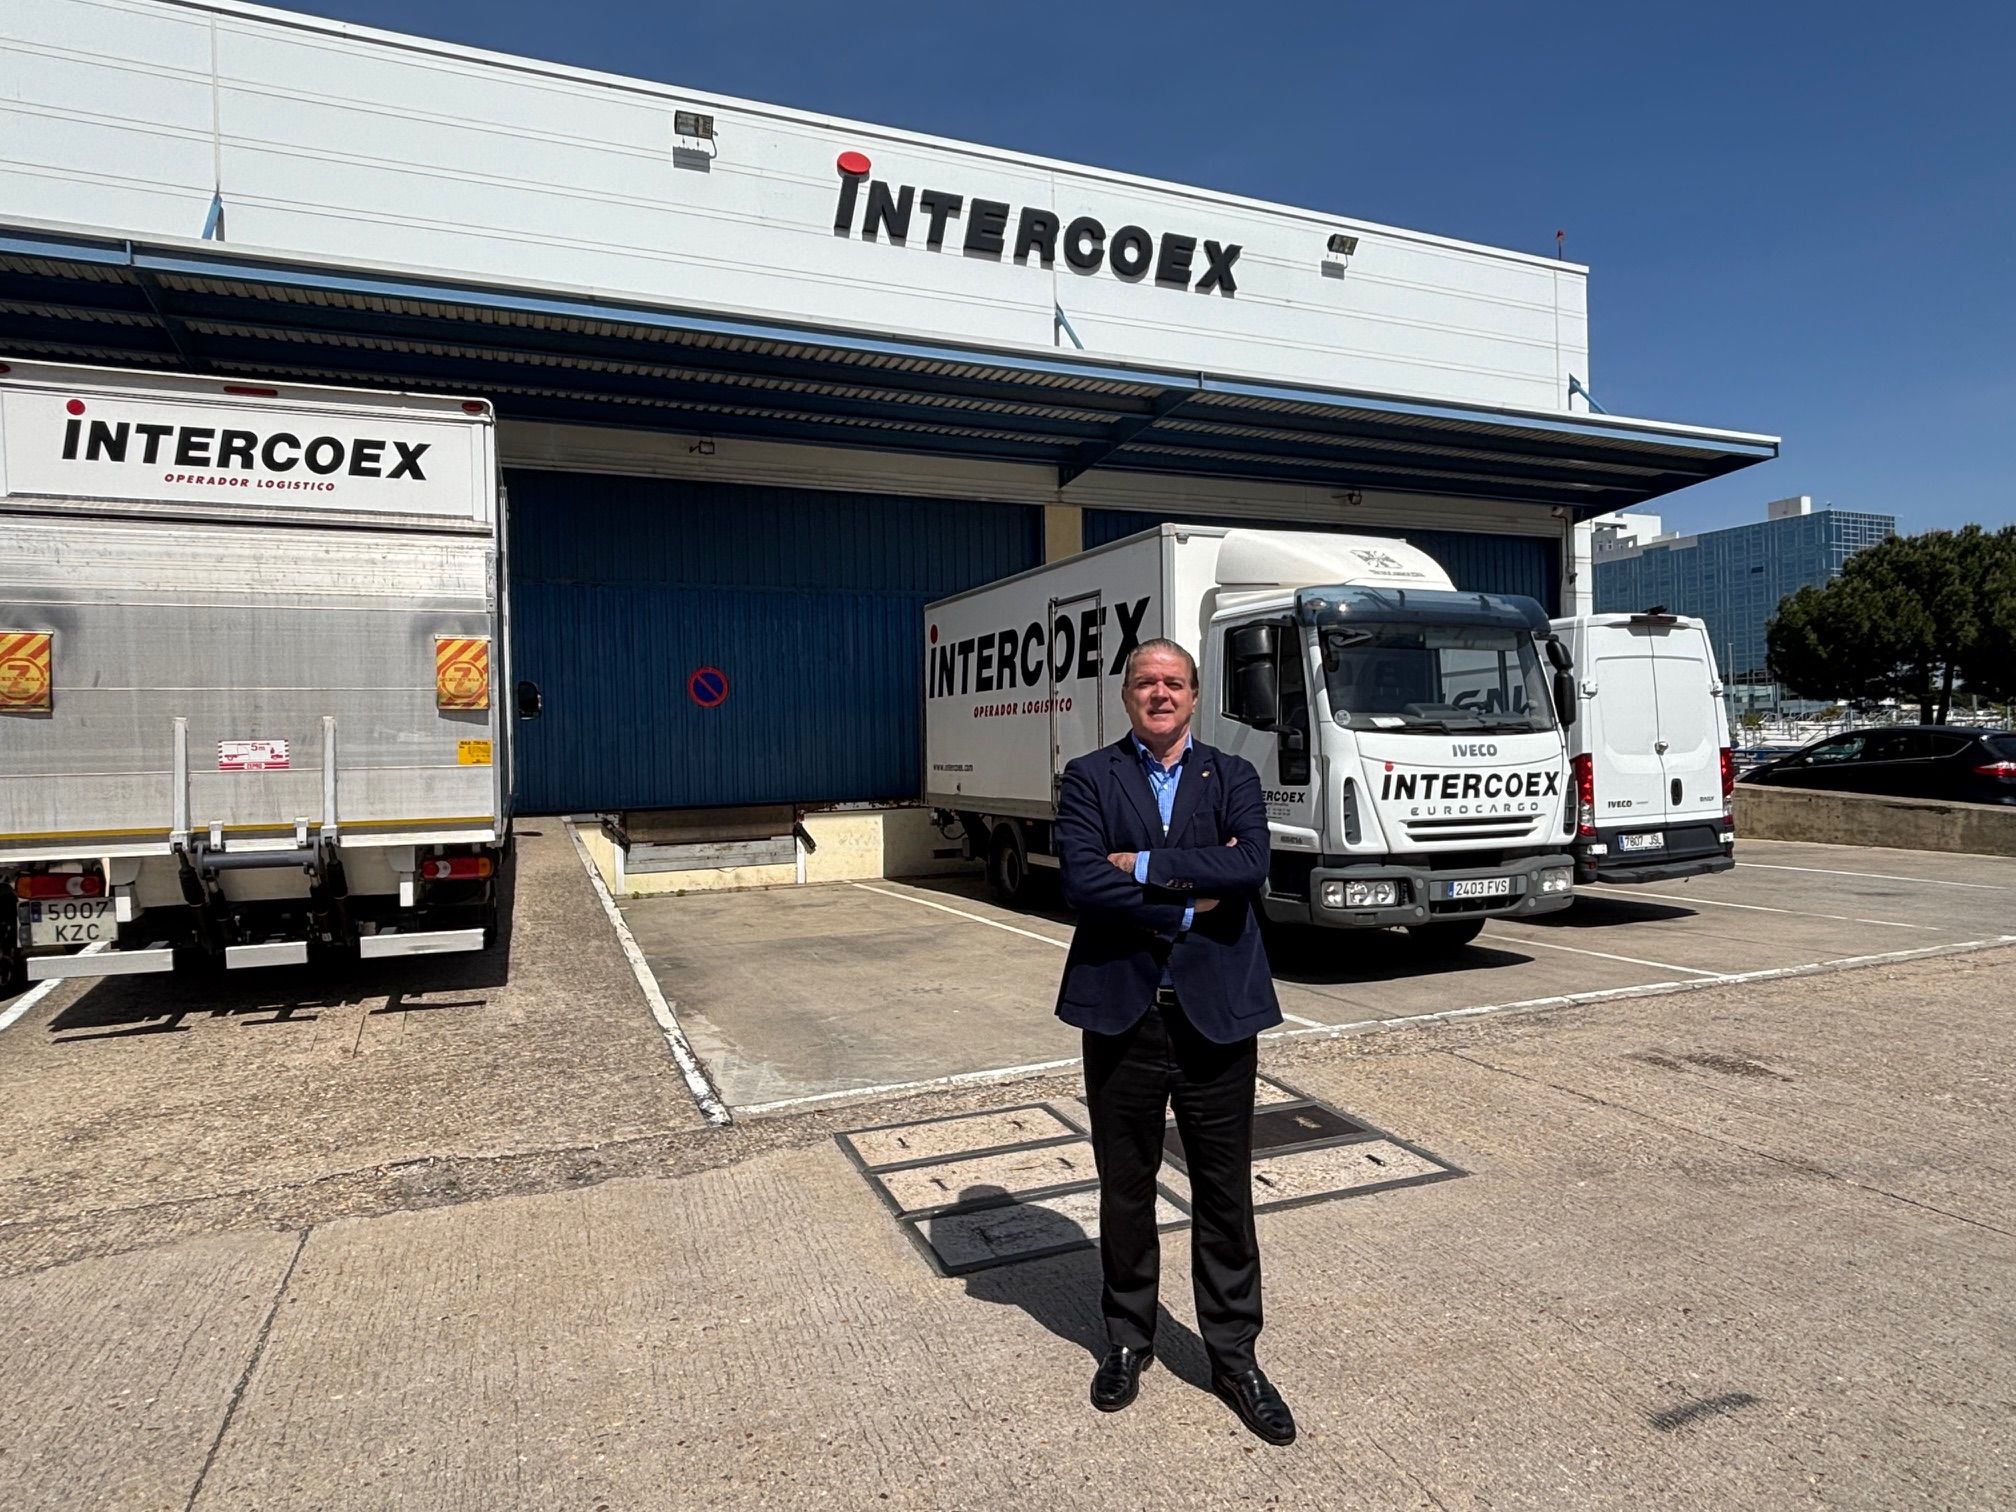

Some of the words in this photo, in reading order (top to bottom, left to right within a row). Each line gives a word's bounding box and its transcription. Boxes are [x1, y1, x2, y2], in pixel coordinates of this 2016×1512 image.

[164, 473, 249, 488] OPERADOR
[257, 479, 335, 492] LOGISTICO
[973, 702, 1018, 718] OPERADOR
[1452, 743, 1498, 757] IVECO
[1262, 790, 1305, 803] ERCOEX
[1608, 800, 1632, 808] IVECO
[1410, 802, 1539, 816] EUROCARGO
[1456, 882, 1484, 896] 2403
[1487, 880, 1507, 894] FVS
[48, 902, 108, 921] 5007
[55, 923, 100, 942] KZC
